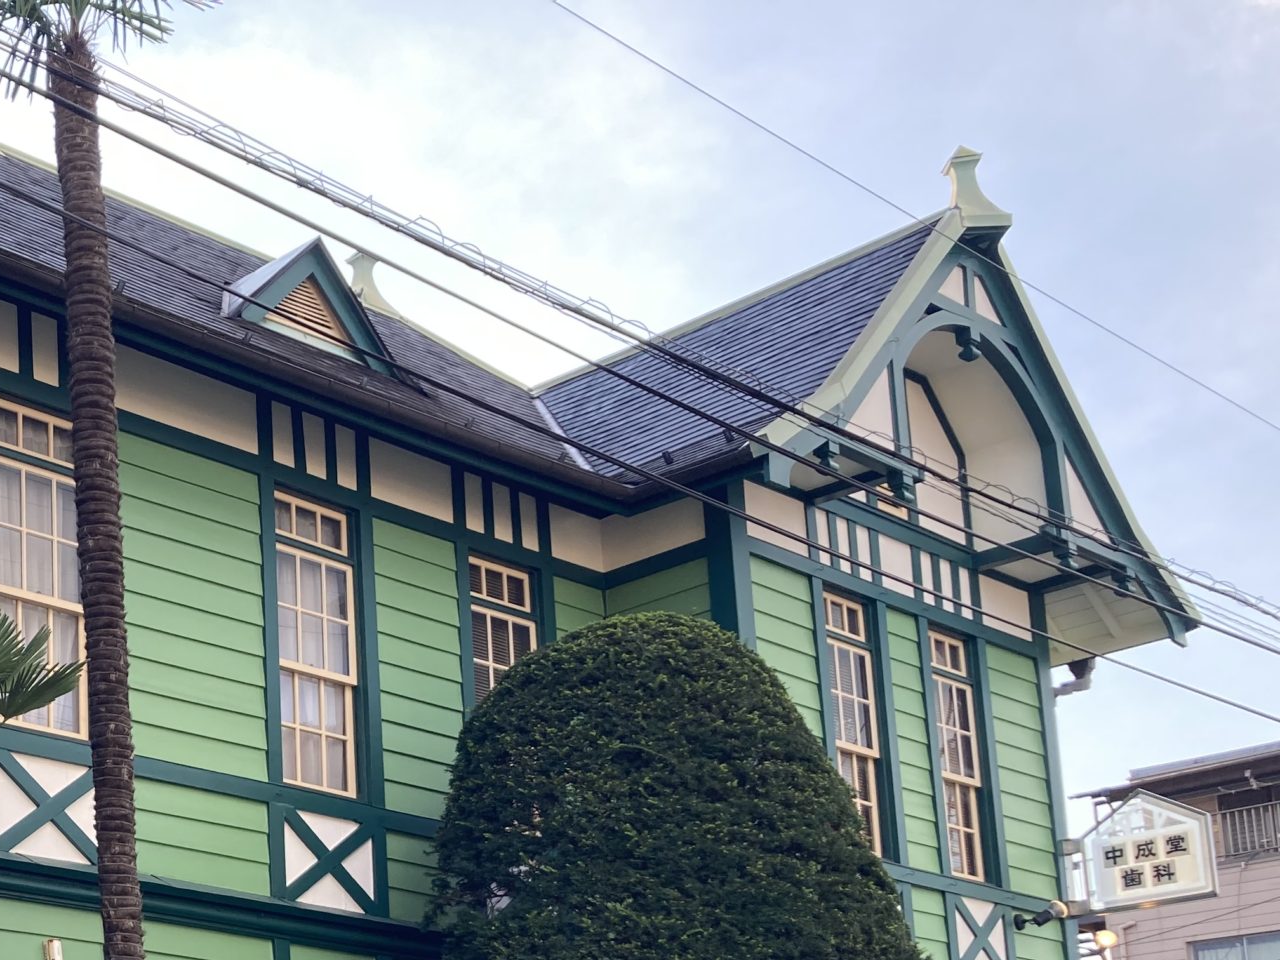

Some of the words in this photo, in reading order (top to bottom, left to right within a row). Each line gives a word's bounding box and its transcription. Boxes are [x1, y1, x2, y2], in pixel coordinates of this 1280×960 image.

[1105, 835, 1187, 865] 中成堂
[1122, 864, 1174, 888] 歯科
